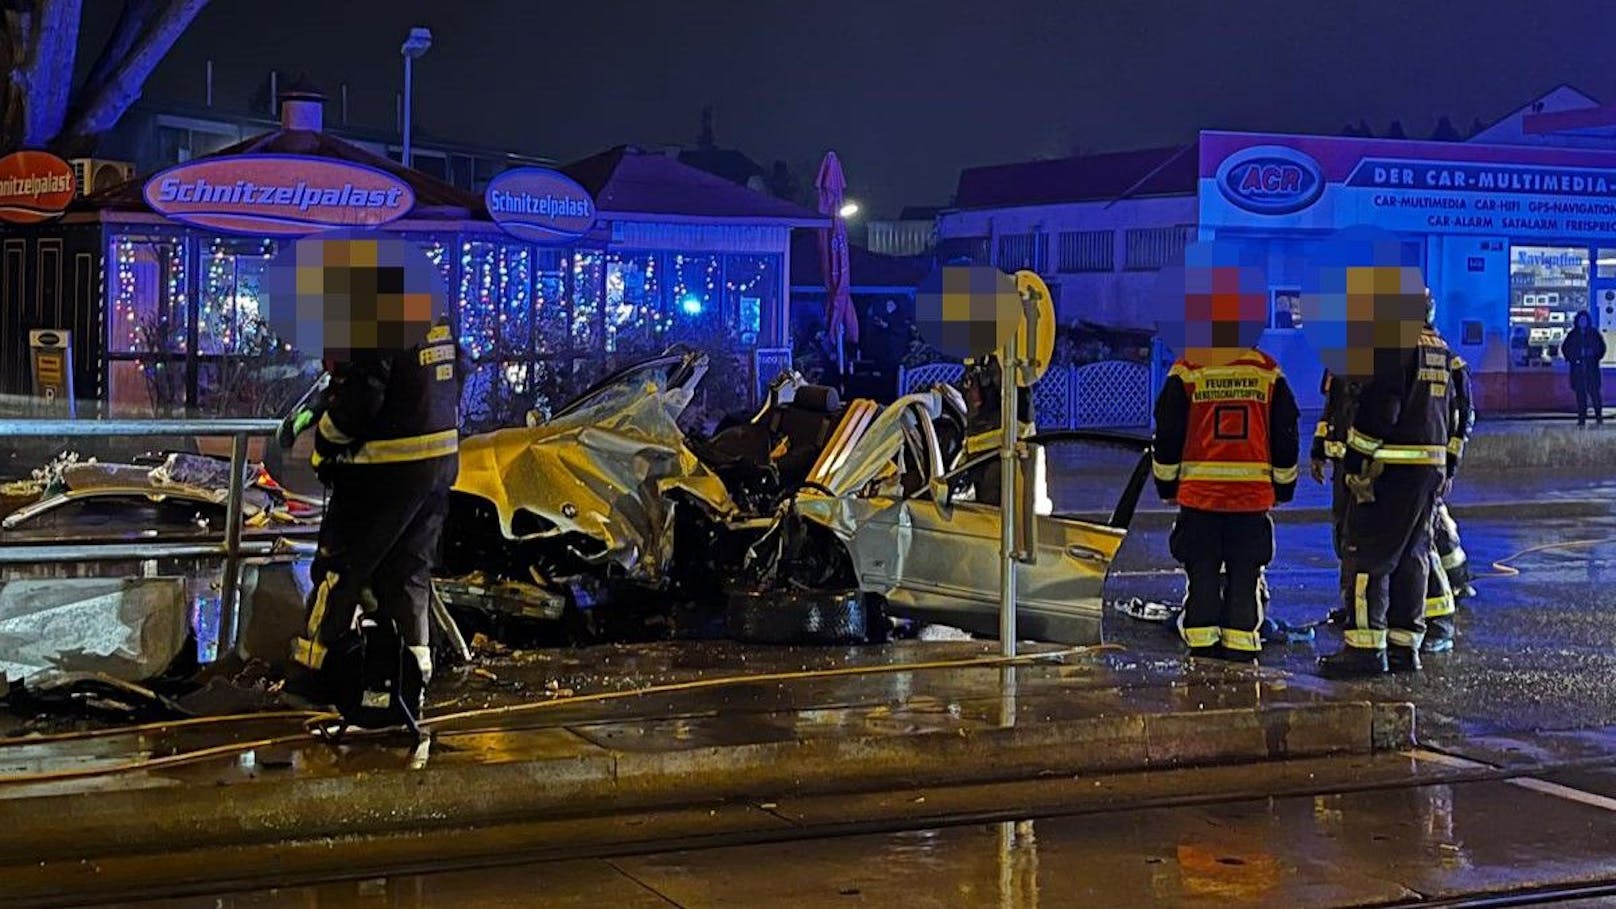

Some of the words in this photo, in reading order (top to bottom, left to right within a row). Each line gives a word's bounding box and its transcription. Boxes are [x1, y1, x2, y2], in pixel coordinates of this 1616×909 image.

[1374, 167, 1414, 185] DER
[159, 178, 401, 210] Schnitzelpalast
[491, 190, 589, 218] Schnitzelpalast
